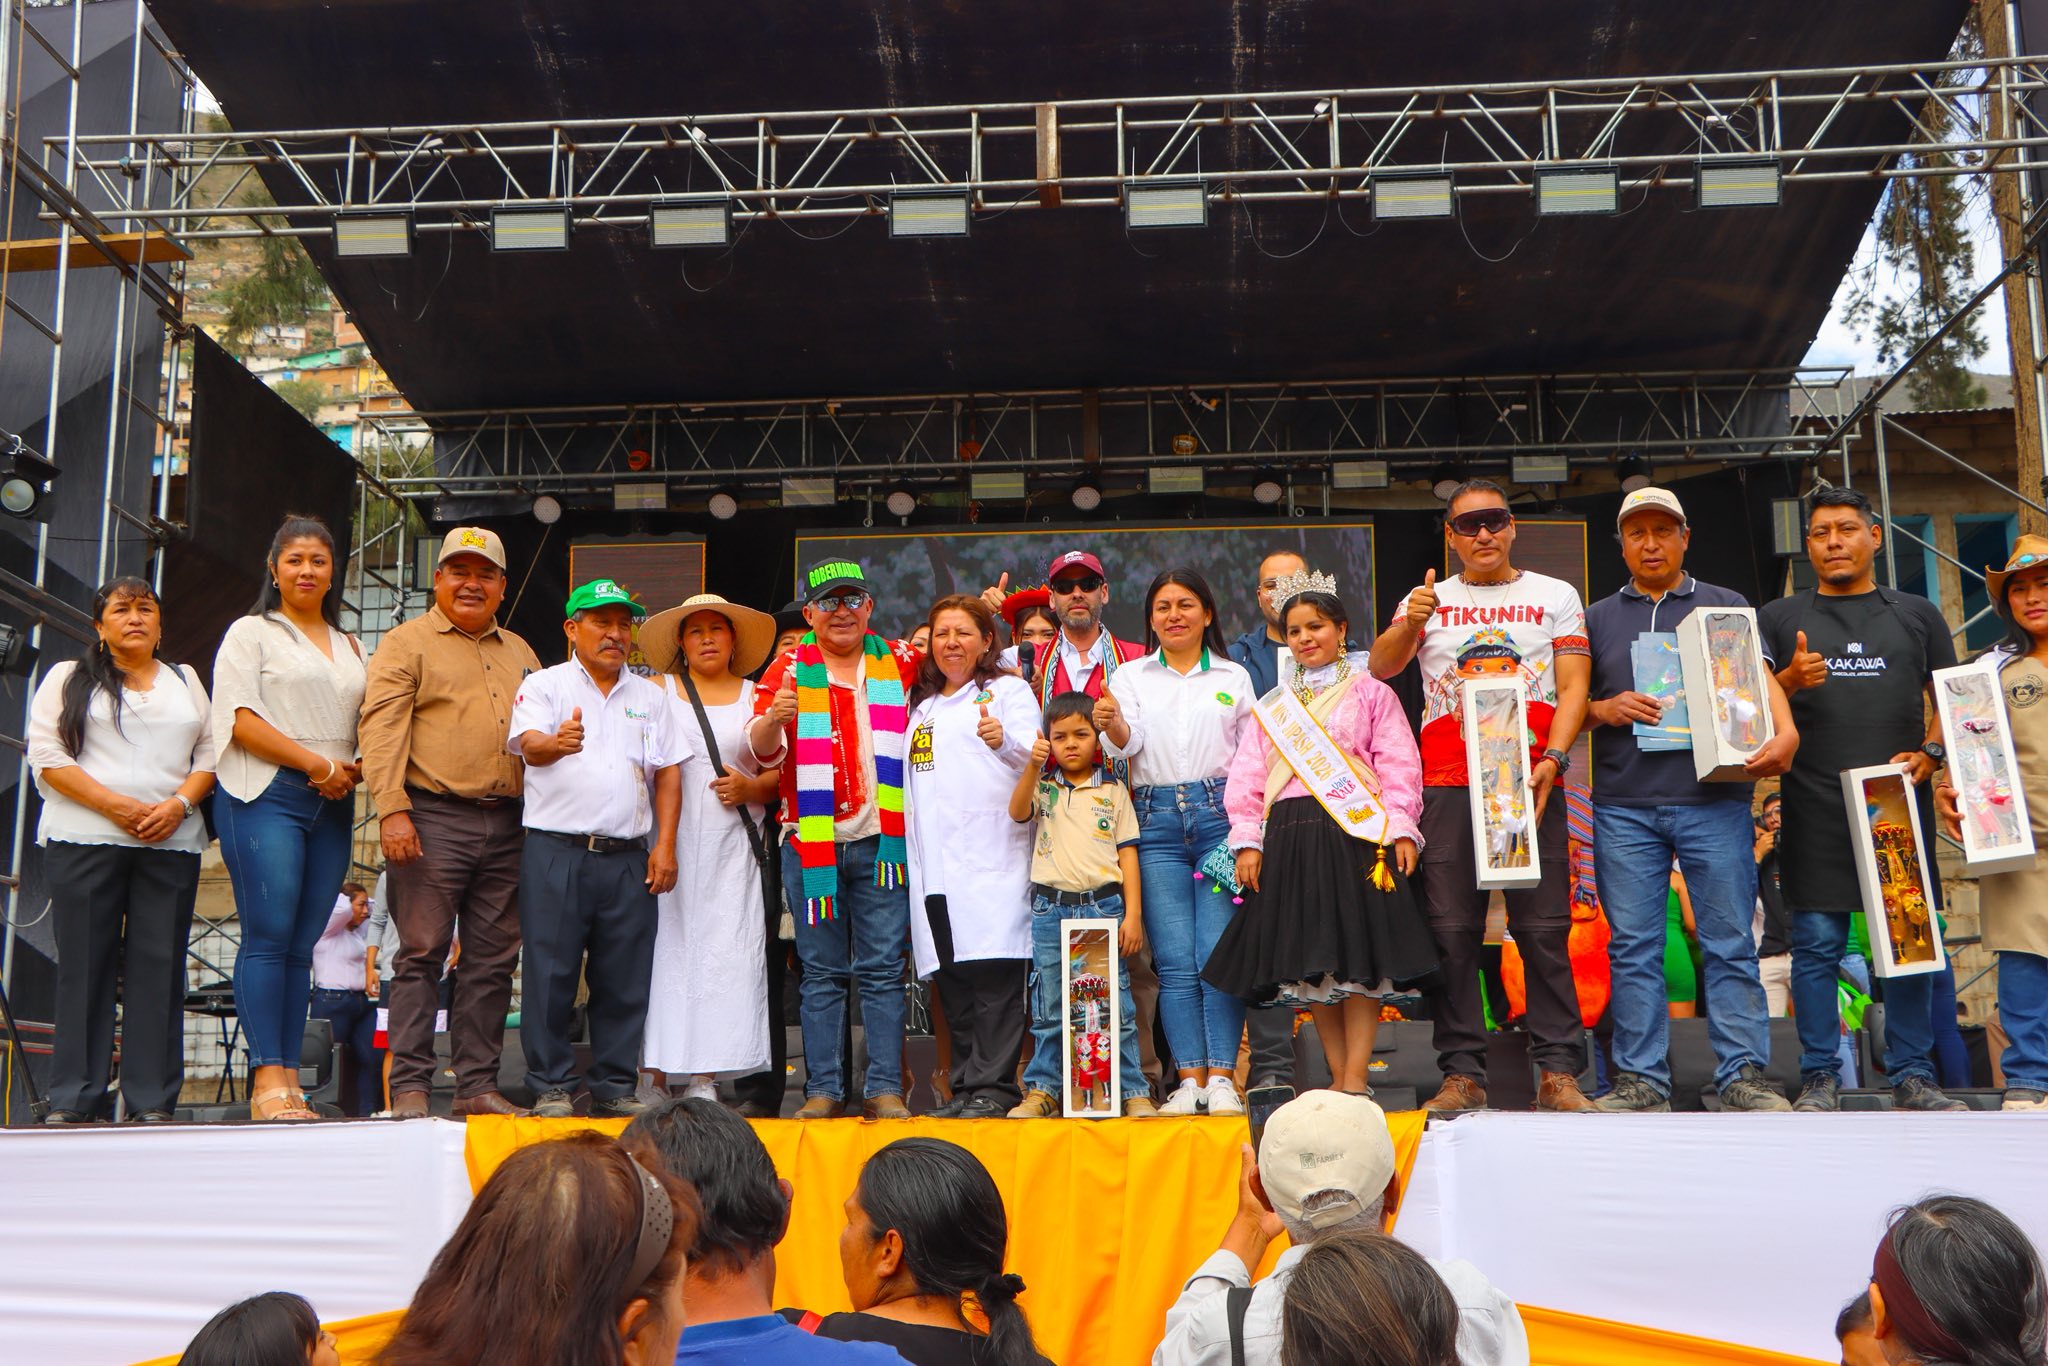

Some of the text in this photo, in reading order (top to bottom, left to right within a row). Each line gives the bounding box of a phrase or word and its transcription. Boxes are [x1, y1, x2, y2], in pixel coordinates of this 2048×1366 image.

[1824, 657, 1886, 670] KAKAWA
[916, 762, 934, 772] 202
[1306, 751, 1336, 781] 2026
